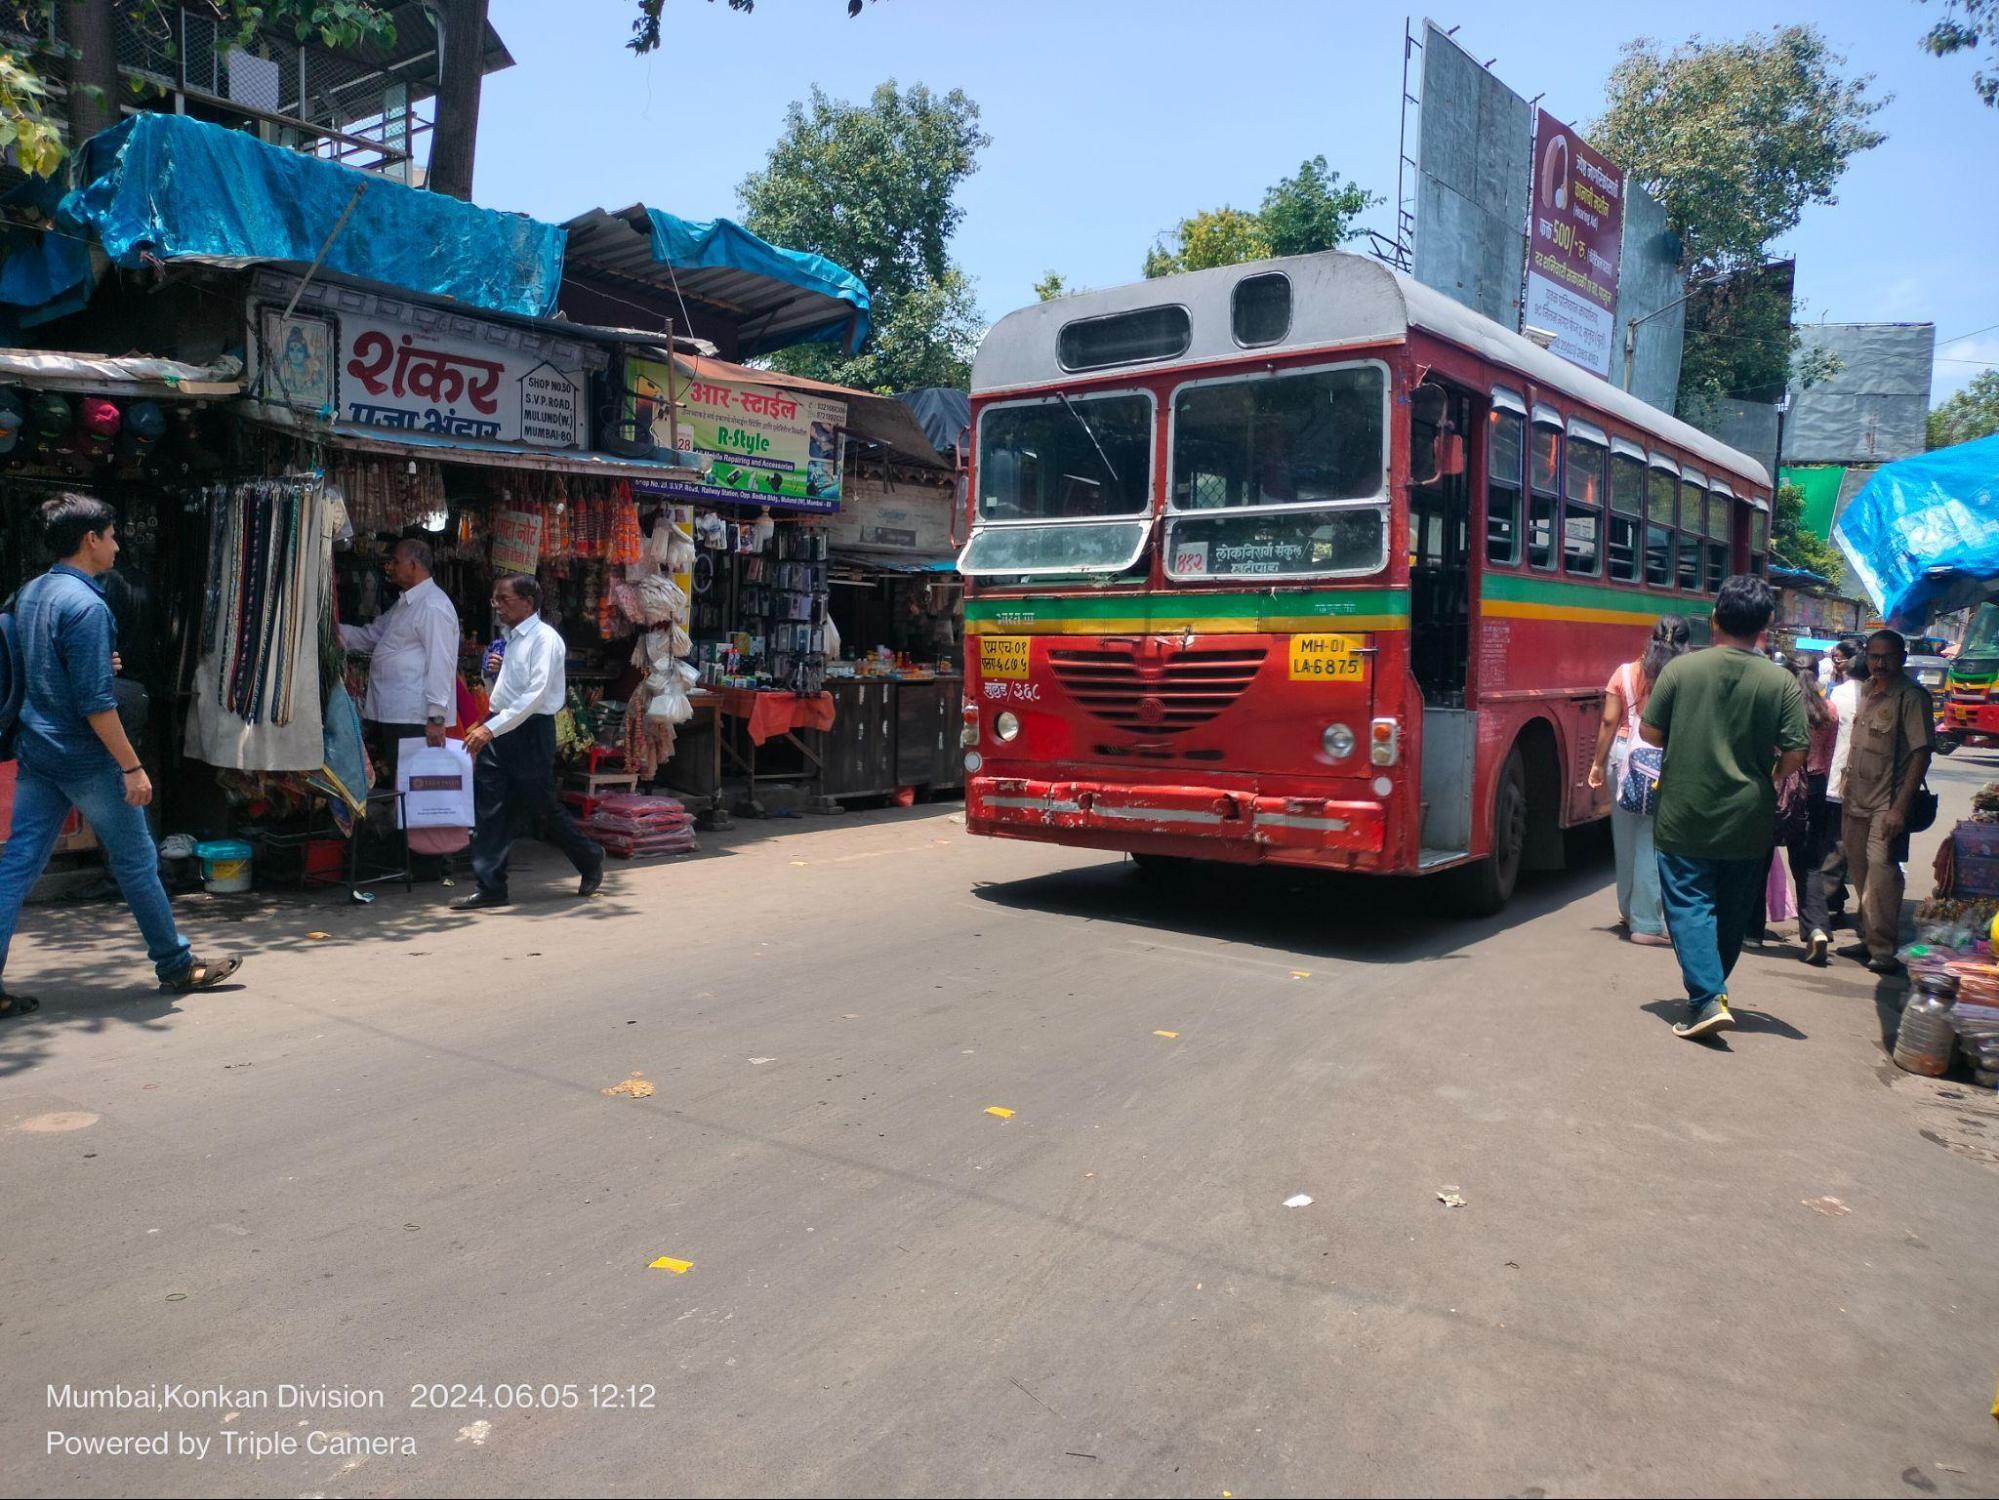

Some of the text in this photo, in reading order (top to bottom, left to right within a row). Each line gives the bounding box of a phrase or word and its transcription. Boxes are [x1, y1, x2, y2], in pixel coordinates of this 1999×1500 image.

[347, 330, 505, 415] शंकर
[528, 377, 550, 390] SHOP
[349, 402, 420, 432] पजा
[677, 437, 691, 452] 28
[718, 426, 769, 455] R-Style
[723, 454, 750, 466] Repairing
[751, 459, 761, 467] and
[762, 459, 794, 471] Accessories
[701, 486, 721, 496] Railway
[1293, 658, 1358, 674] LA-6875
